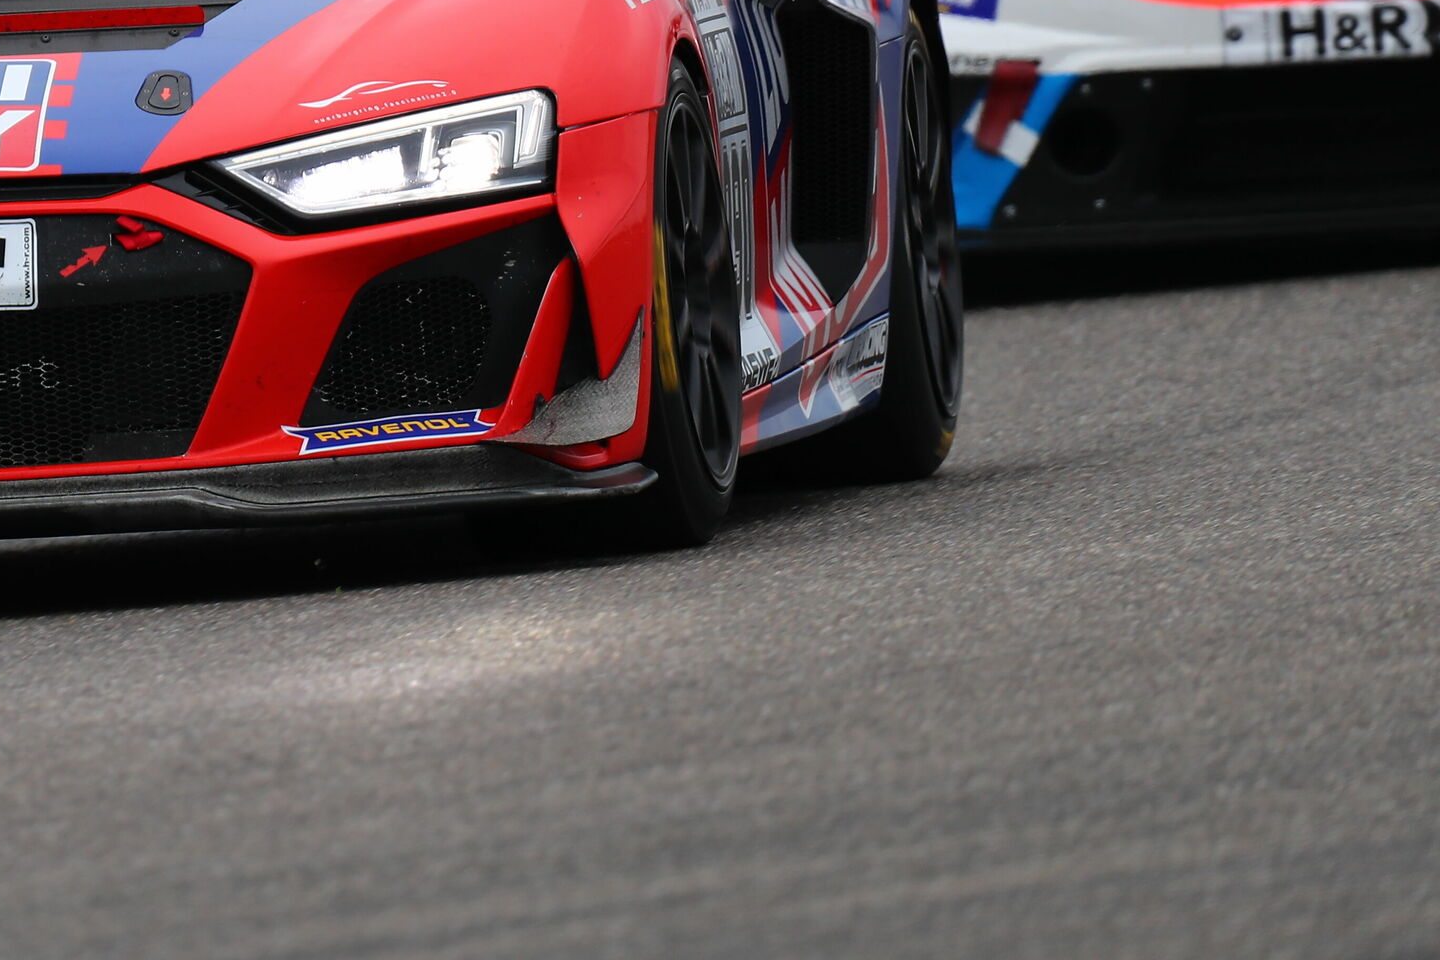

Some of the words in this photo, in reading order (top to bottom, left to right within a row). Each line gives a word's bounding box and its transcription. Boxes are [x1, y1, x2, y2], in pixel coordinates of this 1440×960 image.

[1280, 5, 1412, 57] H&R
[22, 226, 31, 300] www.h-r.com
[314, 417, 471, 442] RAVENOL
